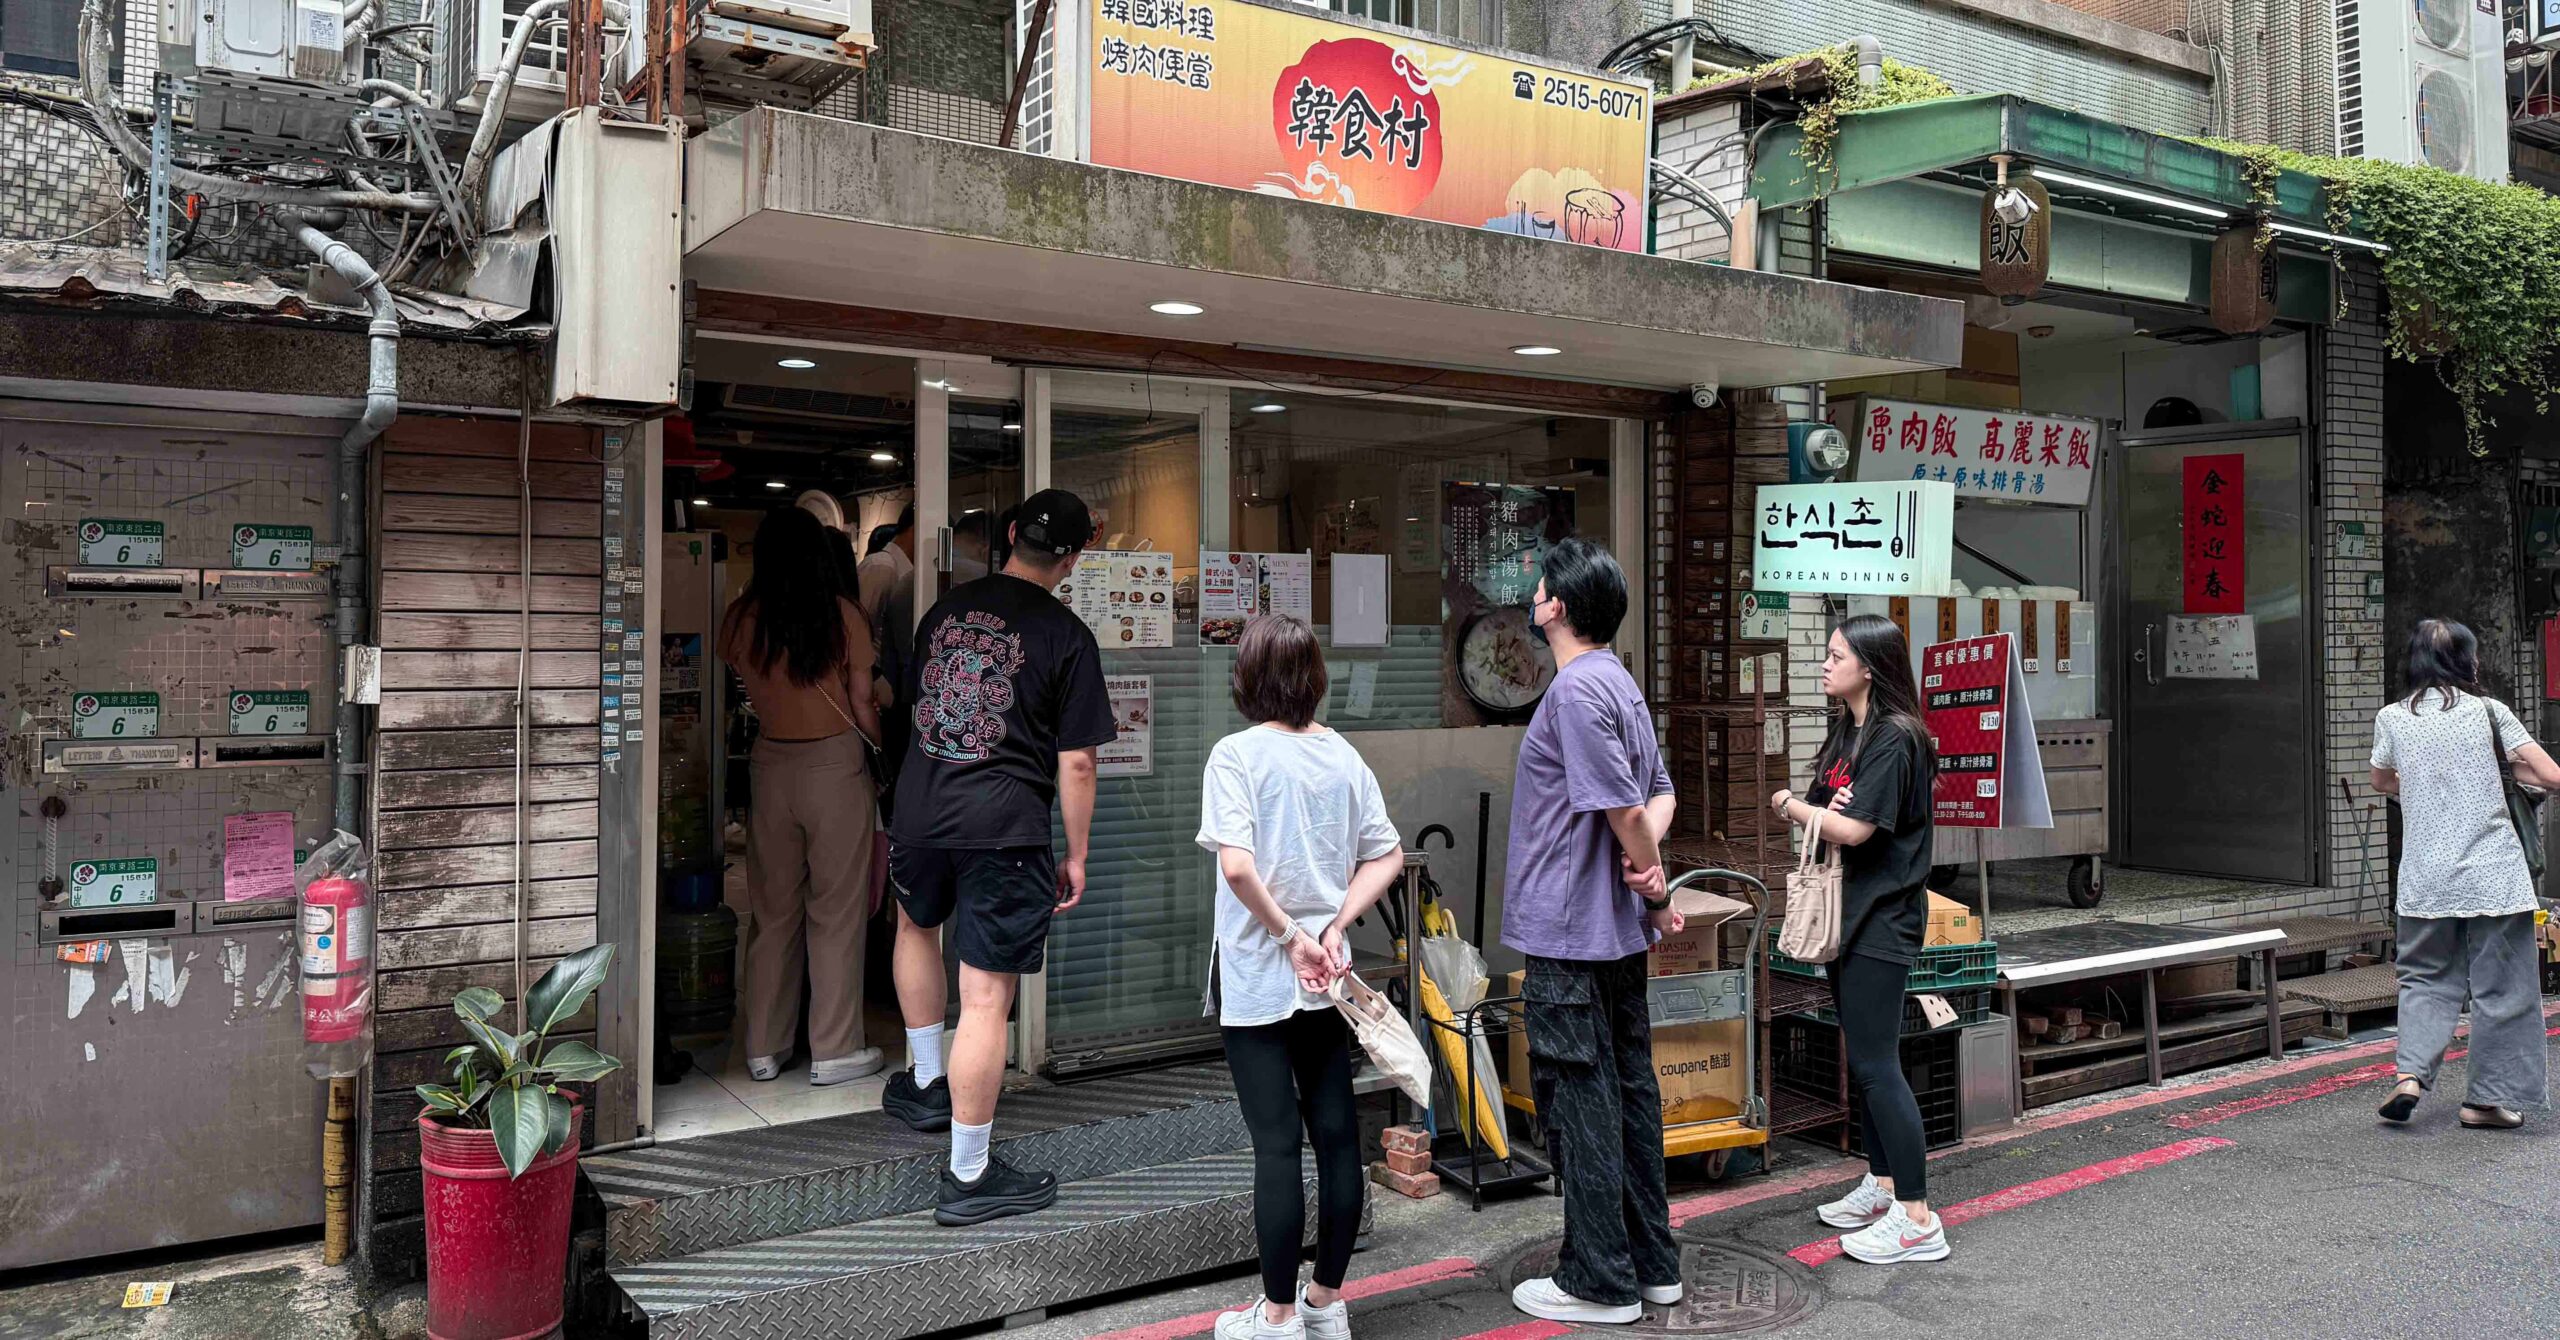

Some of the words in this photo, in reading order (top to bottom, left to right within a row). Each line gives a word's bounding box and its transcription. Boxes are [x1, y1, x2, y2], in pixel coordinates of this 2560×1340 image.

[1100, 0, 1216, 42] 韓國料理
[1099, 37, 1213, 91] 烤肉便當
[1543, 76, 1644, 121] 2515-6071
[1287, 78, 1430, 170] 韓食村
[1866, 405, 1958, 459] 魯肉飯
[1979, 416, 2092, 470] 高麗菜飯
[1911, 463, 2046, 495] 原汁原味排骨湯
[1761, 496, 1883, 550] 한식촌
[2201, 468, 2230, 599] 金蛇迎春
[117, 544, 131, 563] 6
[269, 548, 282, 566] 6
[1501, 501, 1518, 605] 豬肉湯飯
[1205, 568, 1234, 577] 韓式小菜
[1762, 570, 1830, 581] KOREAN
[1840, 572, 1911, 583] DINING
[226, 580, 258, 591] LETTERS
[965, 610, 1006, 631] #KEEP
[1762, 619, 1769, 635] 6
[1934, 644, 1994, 668] 套餐優惠價
[2024, 661, 2037, 671] 130
[2059, 661, 2070, 671] 130
[1105, 680, 1148, 690] 燒肉飯套餐
[112, 716, 126, 736] 6
[265, 714, 279, 732] 6
[110, 884, 124, 902] 6
[1659, 941, 1698, 954] DASIDA
[1660, 1060, 1709, 1078] coupang
[1710, 1052, 1731, 1070] 酷澎
